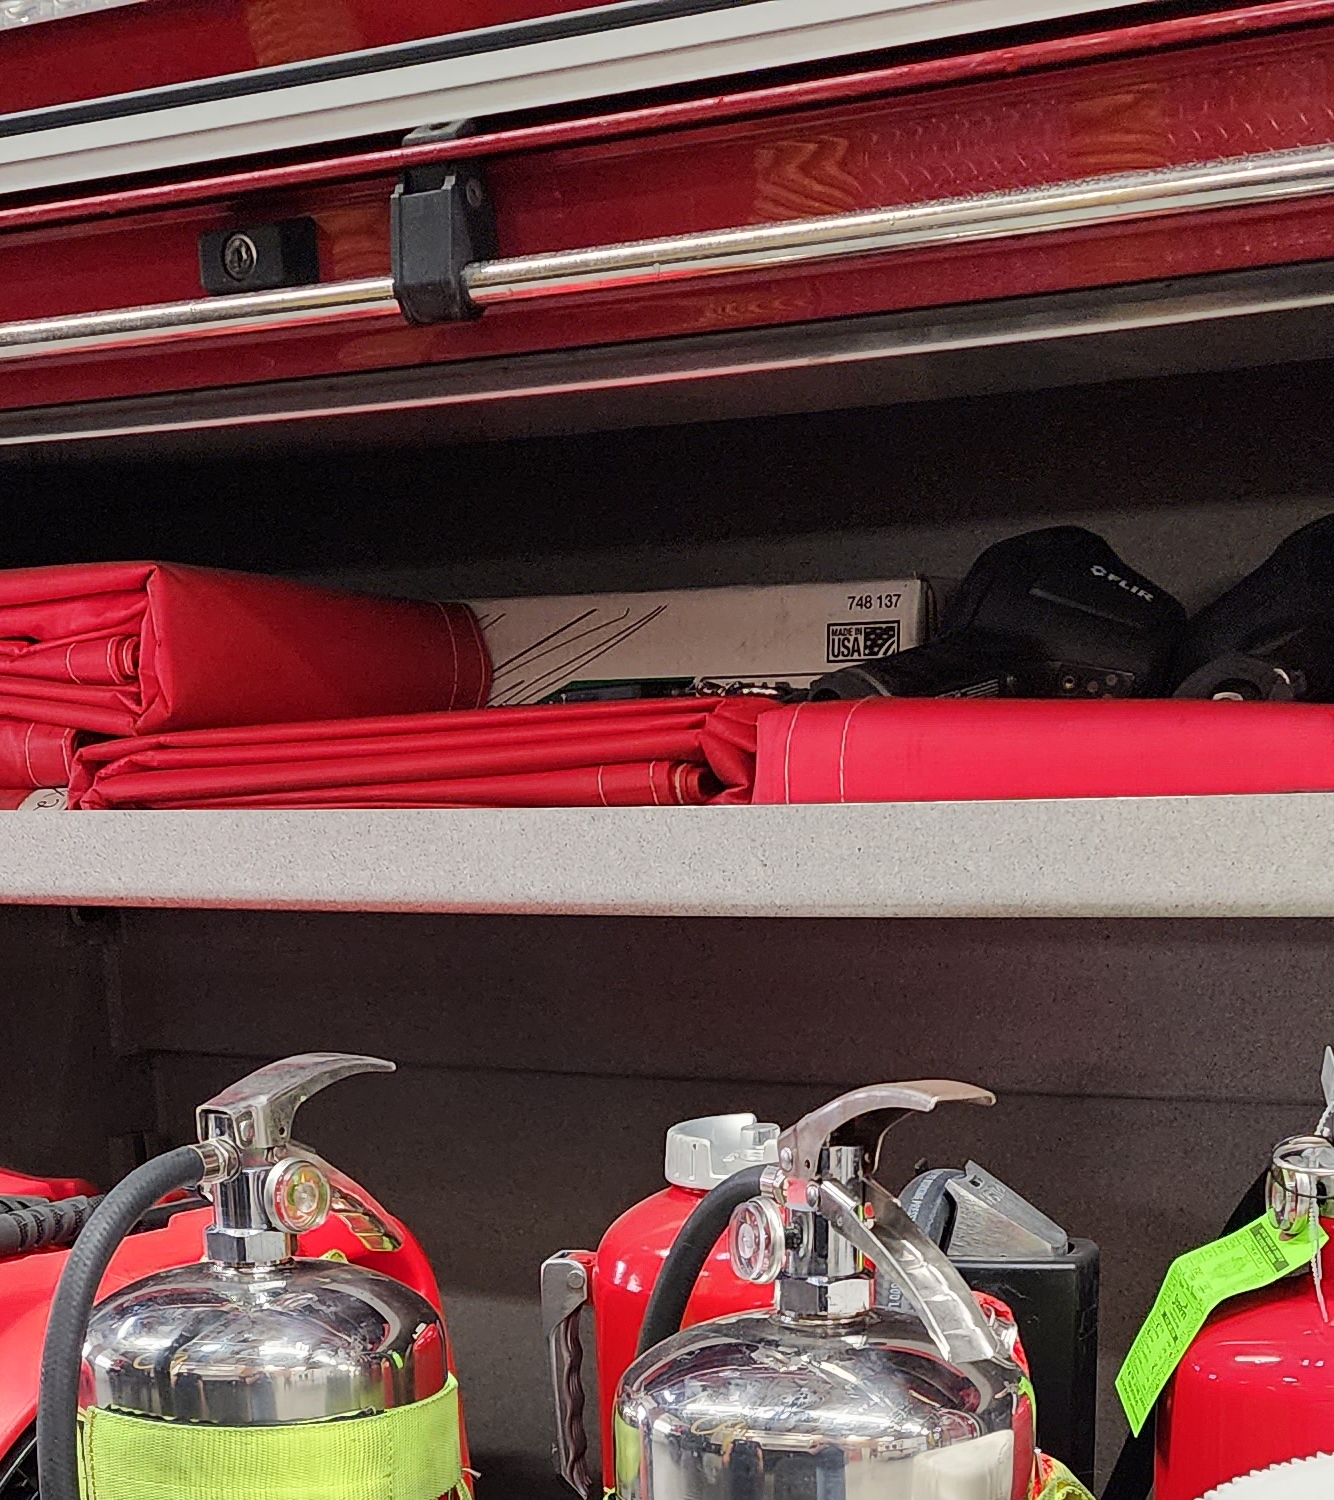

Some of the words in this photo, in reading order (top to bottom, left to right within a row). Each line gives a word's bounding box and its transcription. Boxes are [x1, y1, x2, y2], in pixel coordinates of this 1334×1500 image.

[1107, 573, 1154, 602] FLIR
[847, 595, 873, 610] 748
[877, 593, 902, 609] 137
[831, 627, 854, 637] MADE
[854, 627, 863, 636] IN
[831, 637, 862, 658] USA
